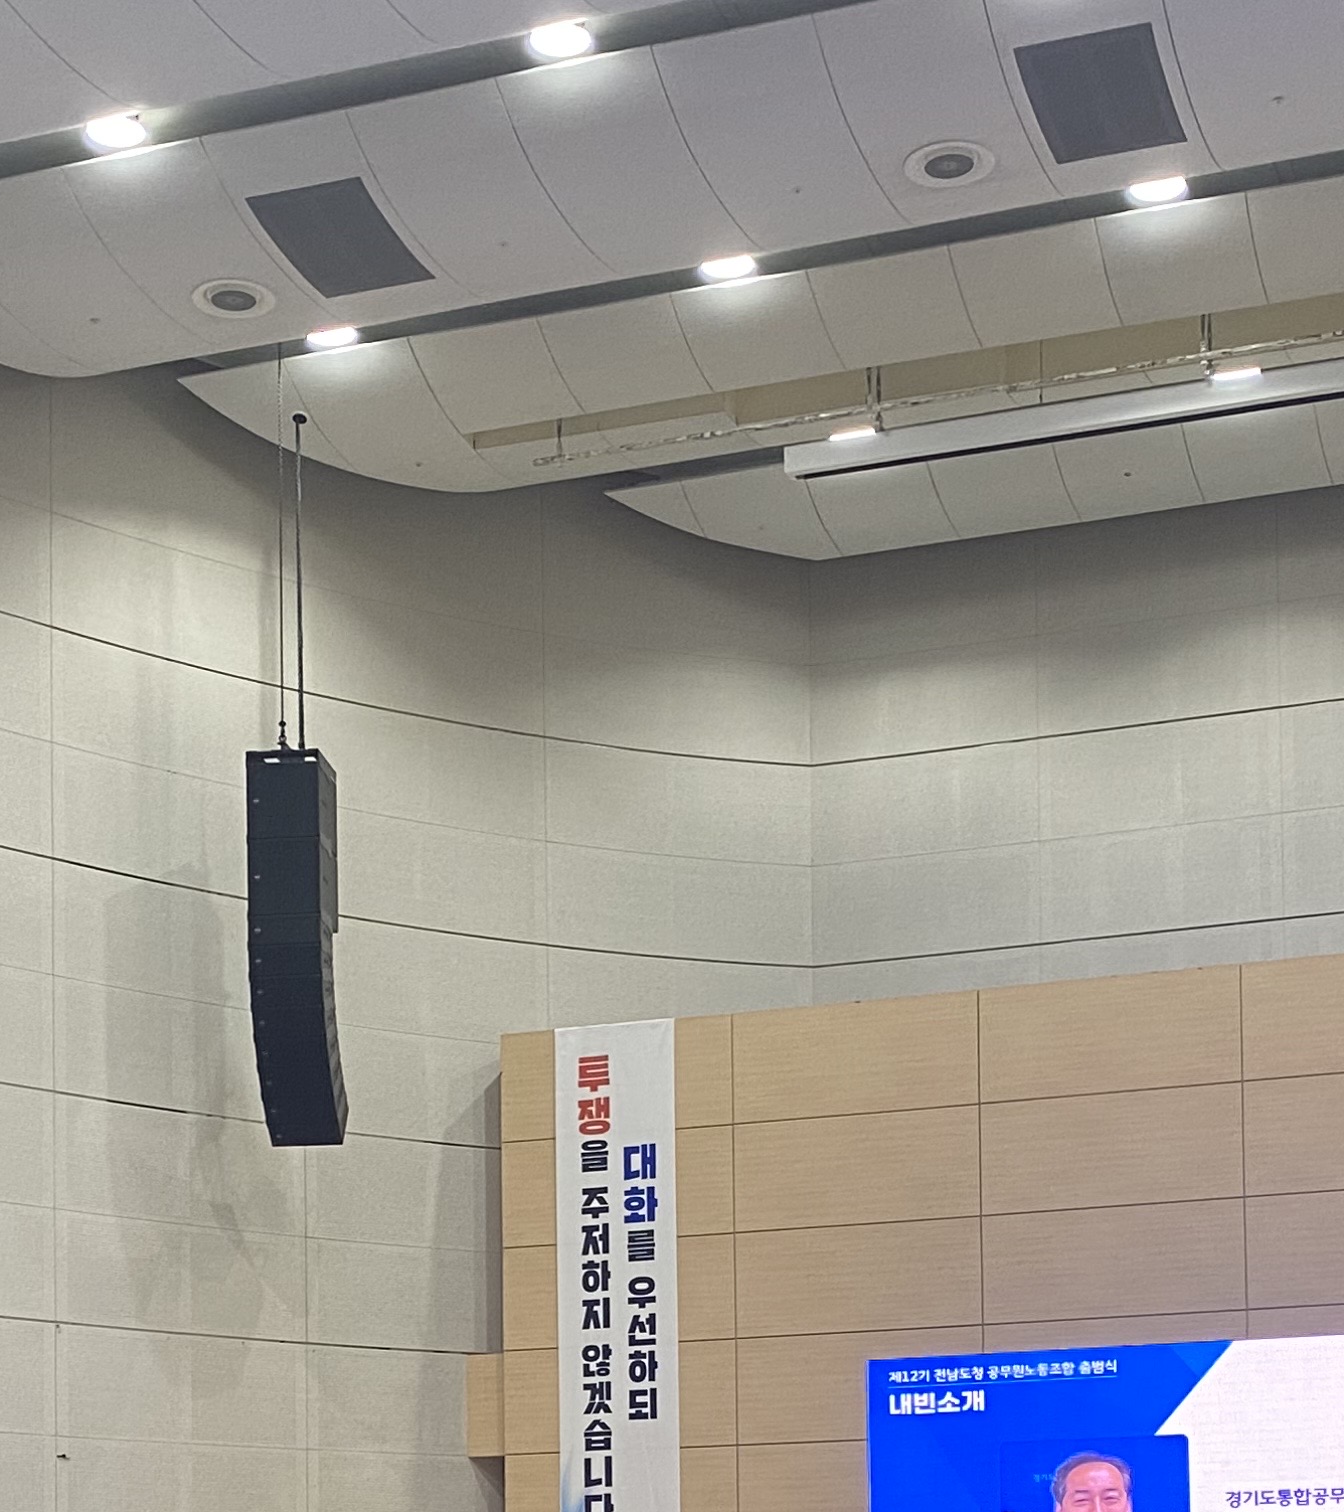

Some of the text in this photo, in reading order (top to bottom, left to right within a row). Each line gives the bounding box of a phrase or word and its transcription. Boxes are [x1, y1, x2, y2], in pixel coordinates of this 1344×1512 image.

[577, 1054, 610, 1173] 투쟁을
[580, 1186, 612, 1330] 주저하지
[623, 1143, 659, 1420] 대화를 우선하되
[888, 1358, 1118, 1384] 제12기 전남도청 공무원노동조합 출범식
[888, 1389, 986, 1416] 내빈소개
